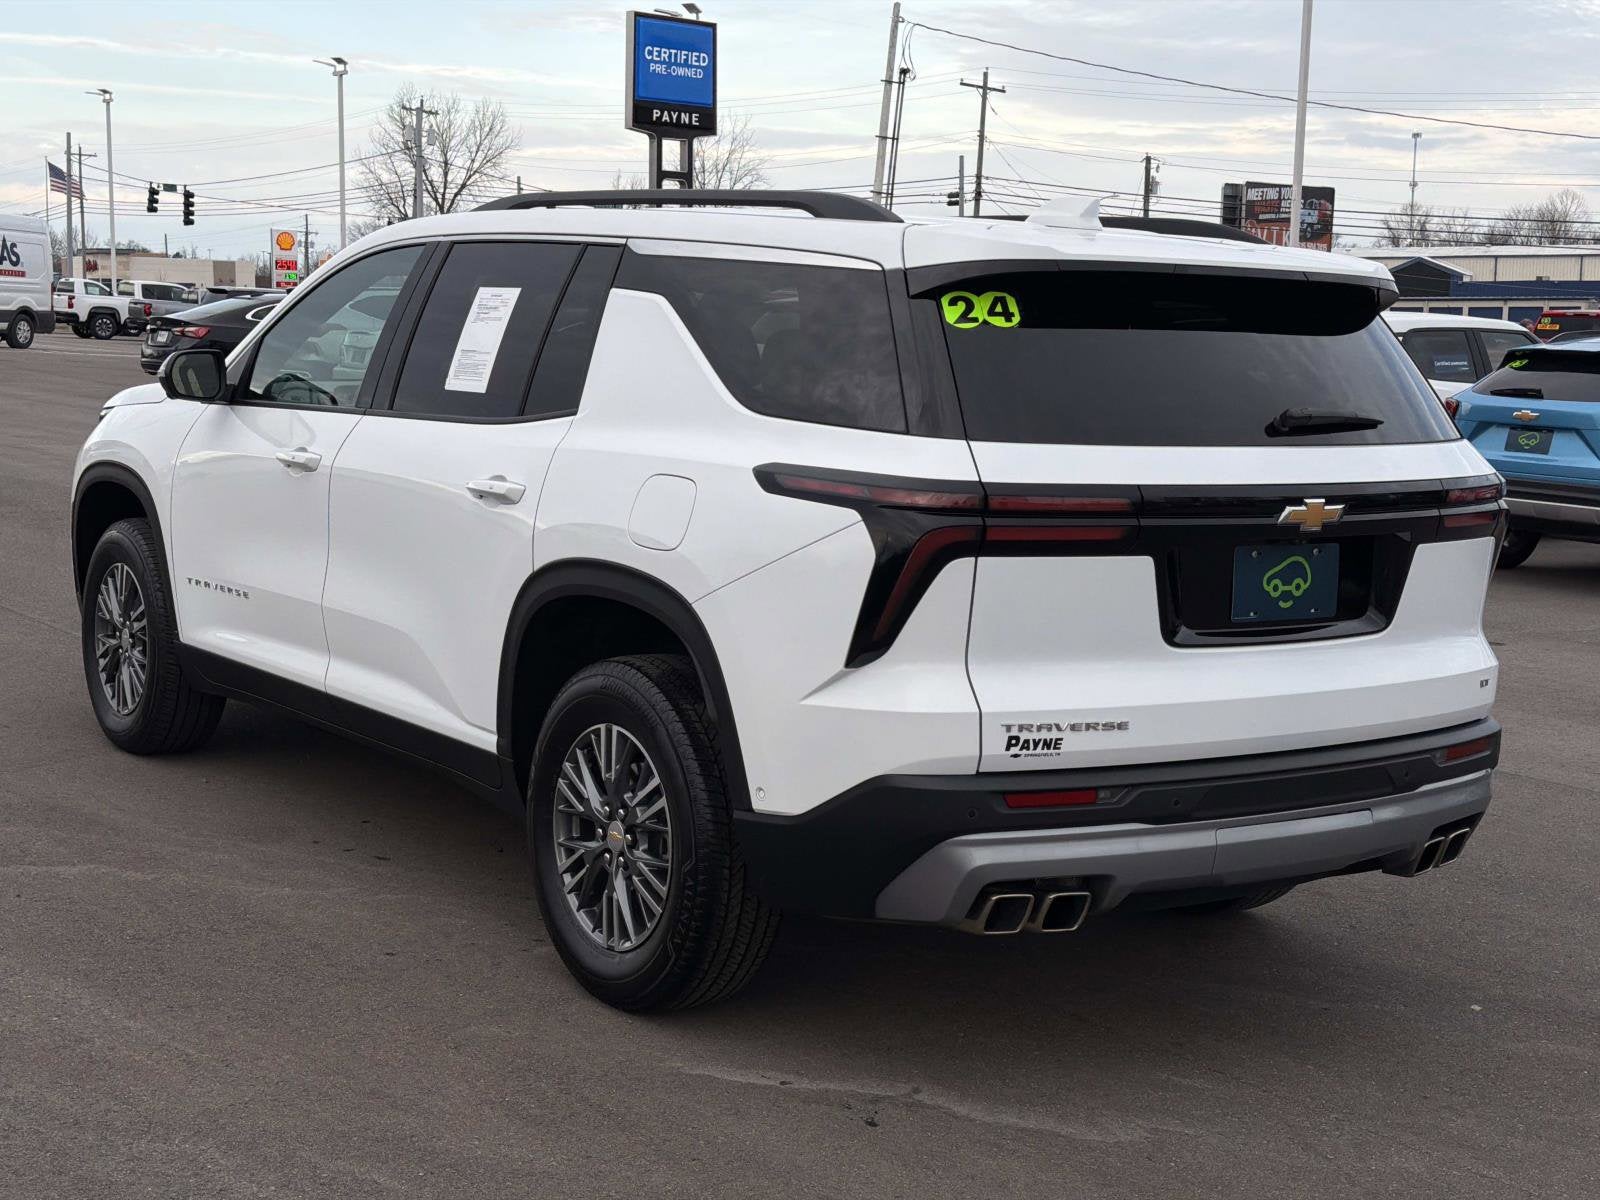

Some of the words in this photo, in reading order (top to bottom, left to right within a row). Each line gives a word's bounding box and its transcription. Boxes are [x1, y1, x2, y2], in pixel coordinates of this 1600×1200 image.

[644, 45, 709, 66] CERTIFIED
[649, 62, 704, 79] PRE-OWNED
[652, 109, 700, 126] PAYNE
[1247, 187, 1280, 201] MEETING
[947, 294, 1016, 325] 24
[186, 576, 250, 600] TRAVERSE
[1001, 721, 1130, 734] TRAVERSE
